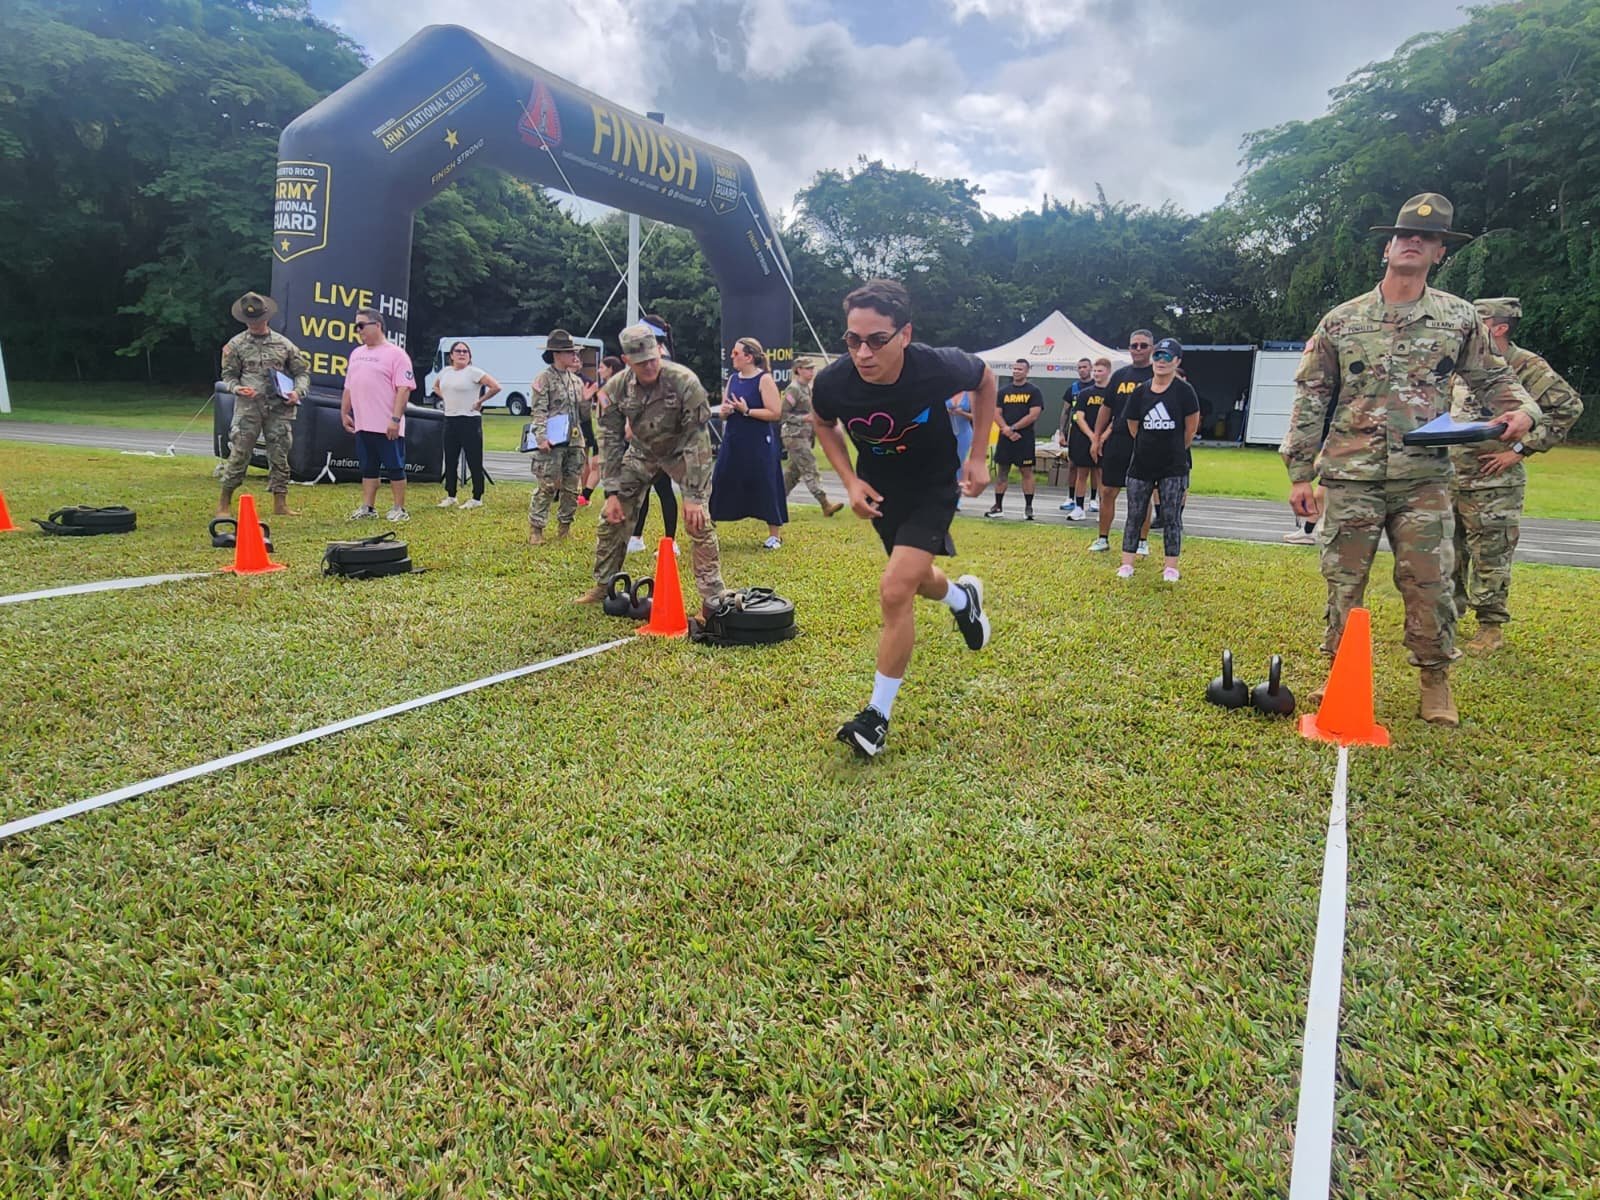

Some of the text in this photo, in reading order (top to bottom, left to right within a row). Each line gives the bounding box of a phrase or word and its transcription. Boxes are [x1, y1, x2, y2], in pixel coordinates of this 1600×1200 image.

[382, 123, 409, 149] ARMY
[405, 98, 449, 131] NATIONAL
[446, 76, 475, 101] GUARD
[592, 103, 698, 191] FINISH
[431, 138, 485, 185] FINISH STRONG
[294, 168, 315, 177] RICO
[274, 201, 317, 214] ATIONAL
[314, 281, 374, 310] LIVE
[300, 315, 363, 344] WOR
[299, 350, 348, 377] SER
[1117, 382, 1143, 395] AR
[1003, 393, 1031, 405] ARMY
[1086, 395, 1105, 406] AR
[1142, 420, 1176, 431] adidas
